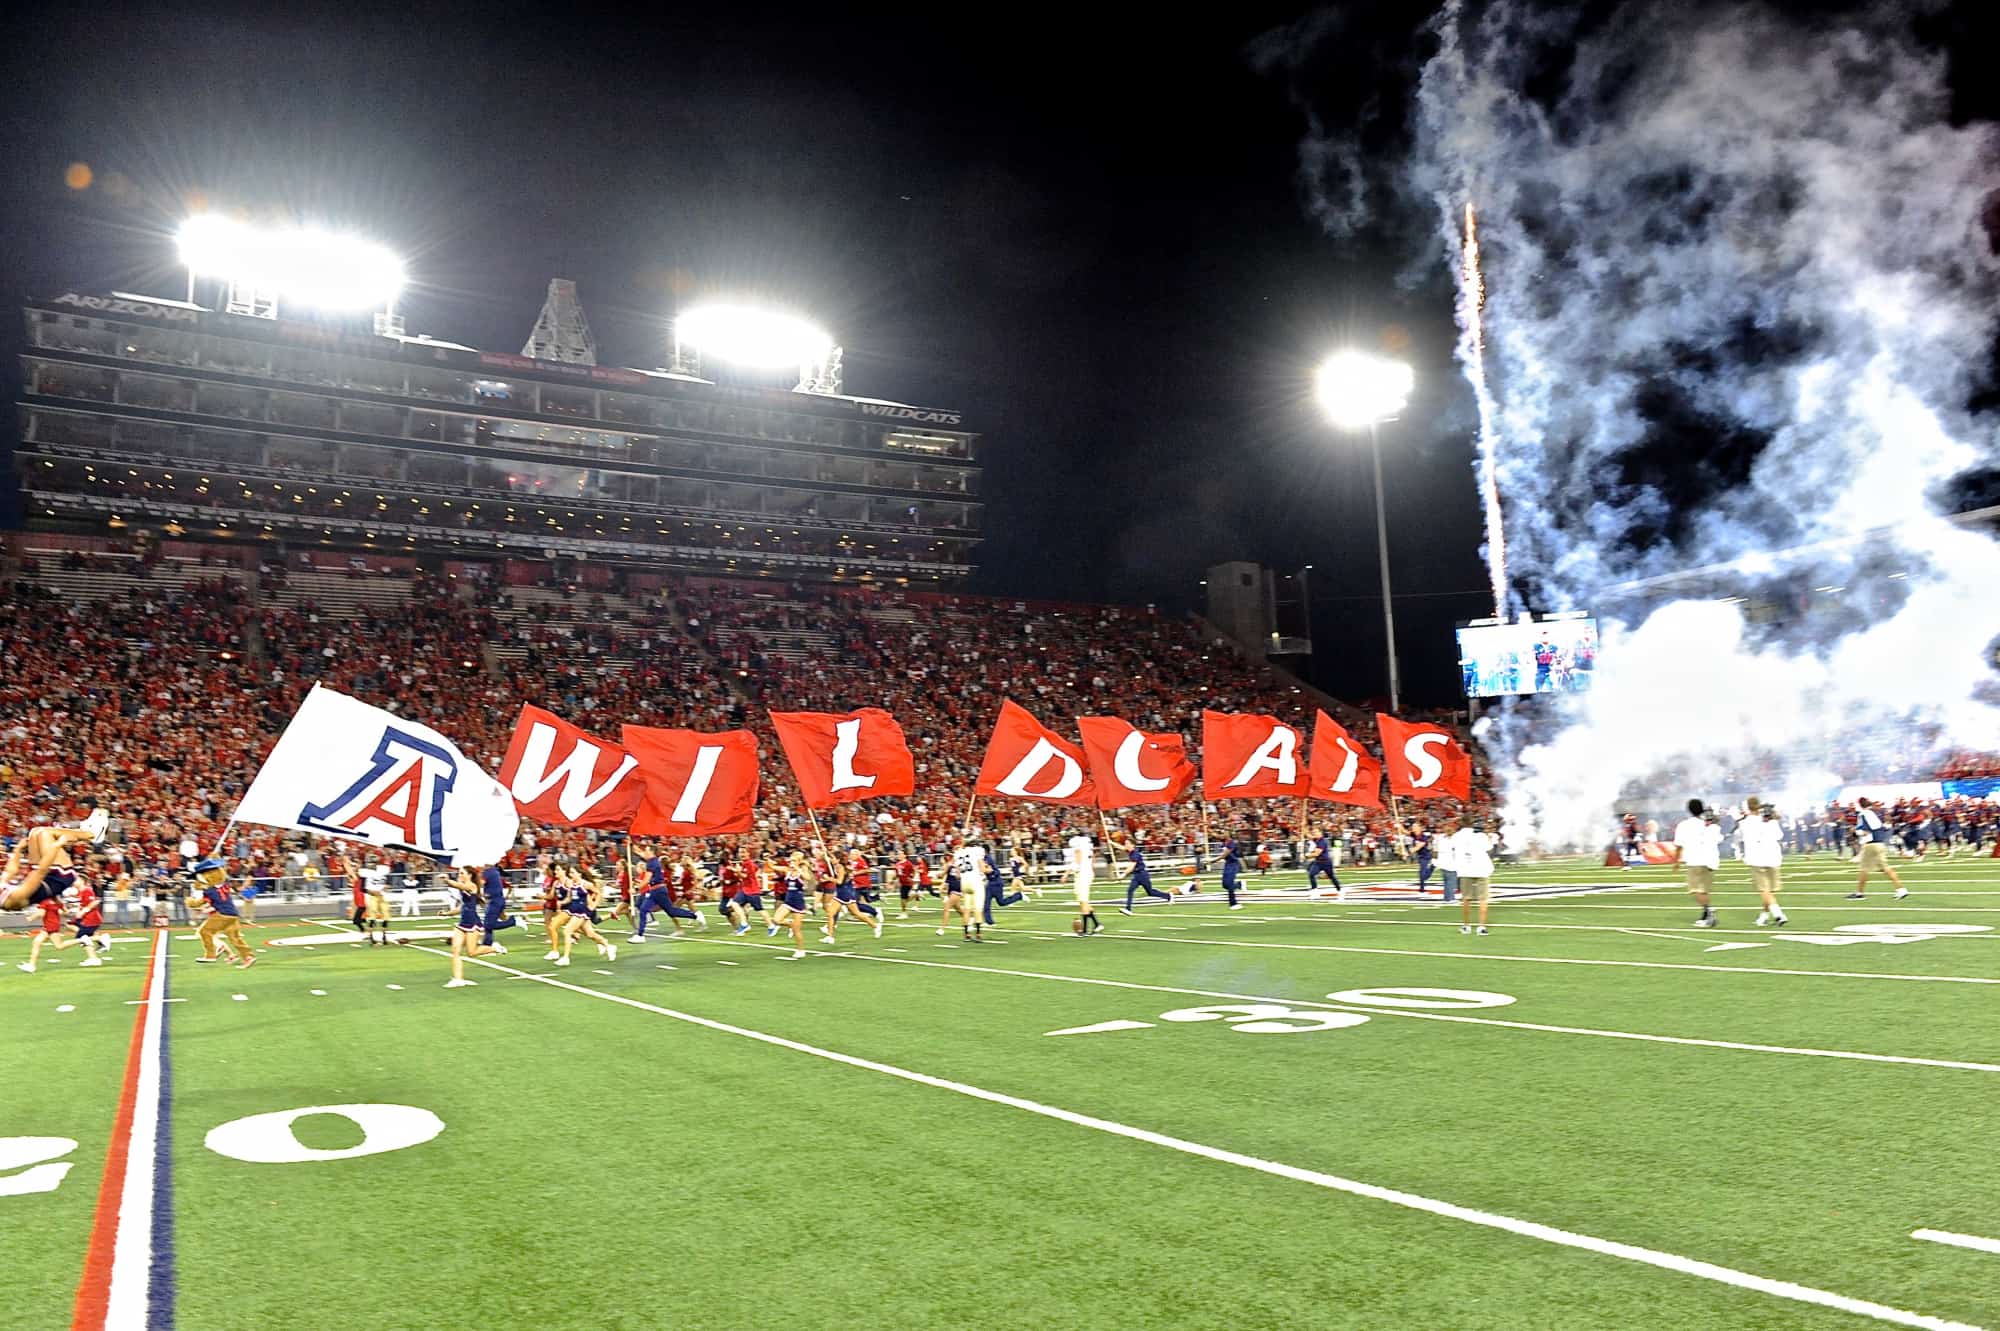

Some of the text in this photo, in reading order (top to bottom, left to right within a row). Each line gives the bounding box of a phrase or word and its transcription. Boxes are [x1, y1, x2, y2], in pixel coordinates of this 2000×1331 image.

[54, 292, 198, 322] ARIZONA
[861, 404, 961, 425] WILDCATS
[512, 721, 639, 821] W
[671, 745, 724, 823] I
[830, 718, 878, 793] L
[995, 736, 1083, 799] D
[1114, 729, 1171, 792] C
[1222, 725, 1296, 789] A
[1404, 732, 1450, 789] S
[297, 725, 458, 865] A
